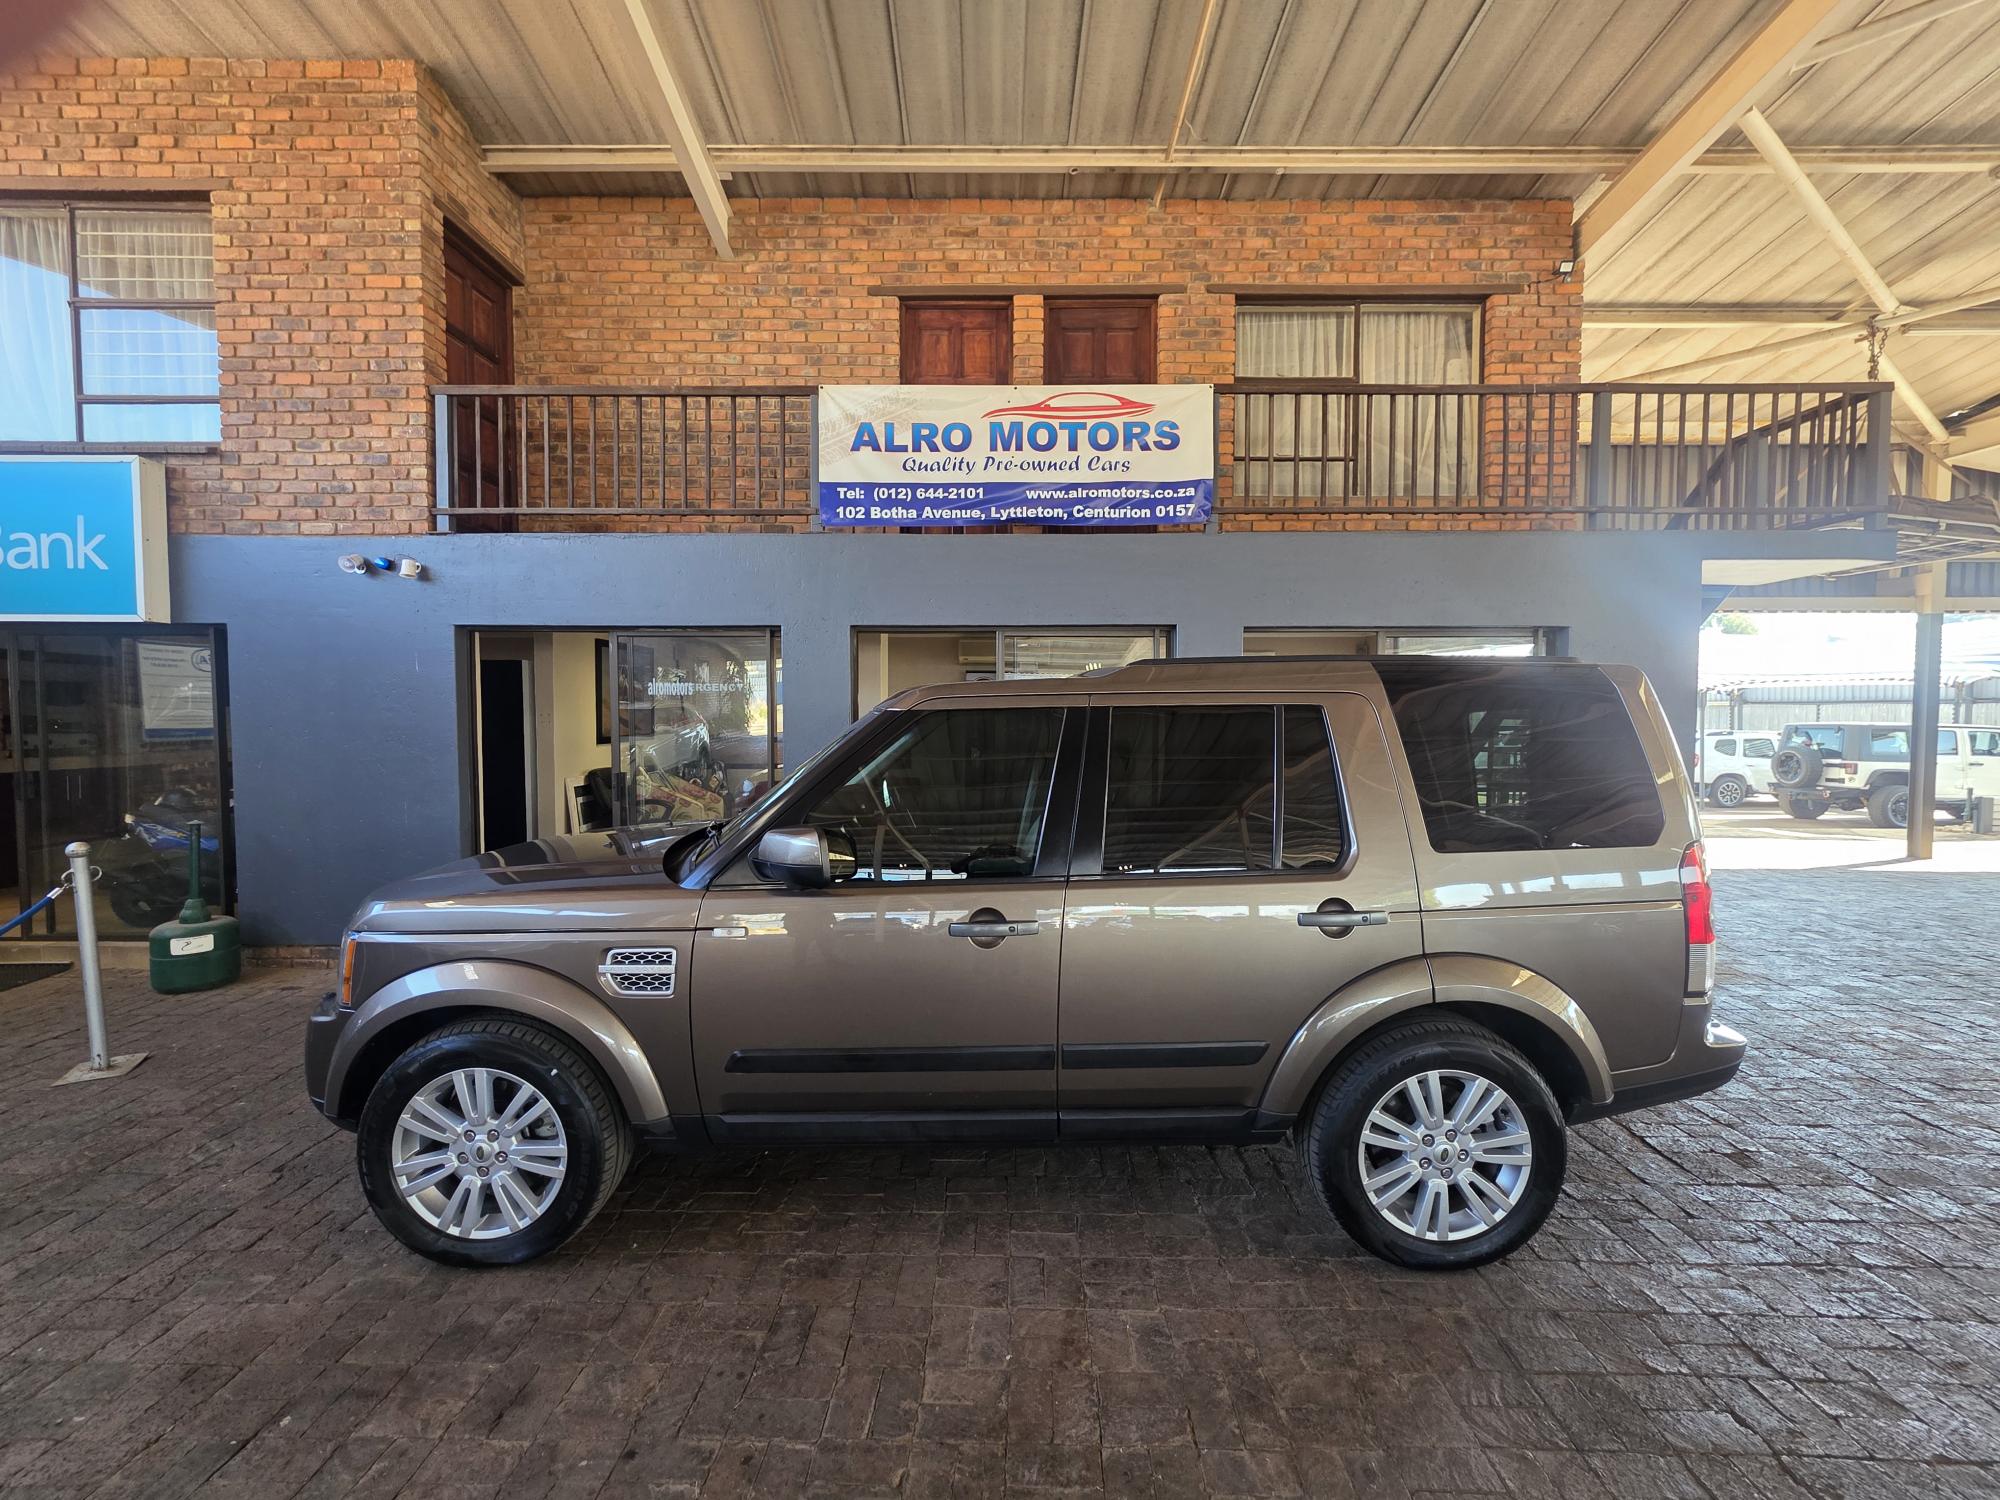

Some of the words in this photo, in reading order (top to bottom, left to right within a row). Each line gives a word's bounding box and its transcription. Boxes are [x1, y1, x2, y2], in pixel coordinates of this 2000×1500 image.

[850, 421, 972, 453] ALRO
[989, 420, 1181, 452] MOTORS
[902, 456, 976, 475] Quality
[983, 455, 1081, 473] Pre-owned
[1087, 455, 1131, 473] Cars
[837, 487, 865, 499] Tel:
[873, 487, 912, 502] (012)
[916, 487, 984, 499] 644-2101
[1026, 486, 1196, 499] www.alromotors.co.za
[836, 506, 866, 519] 102
[870, 506, 917, 519] Botha
[921, 507, 986, 520] Avenue,
[990, 506, 1068, 521] Lyttleton,
[1072, 505, 1151, 518] Centurion
[1155, 504, 1196, 517] 0157
[0, 514, 109, 570] ank
[647, 677, 693, 696] alromotors
